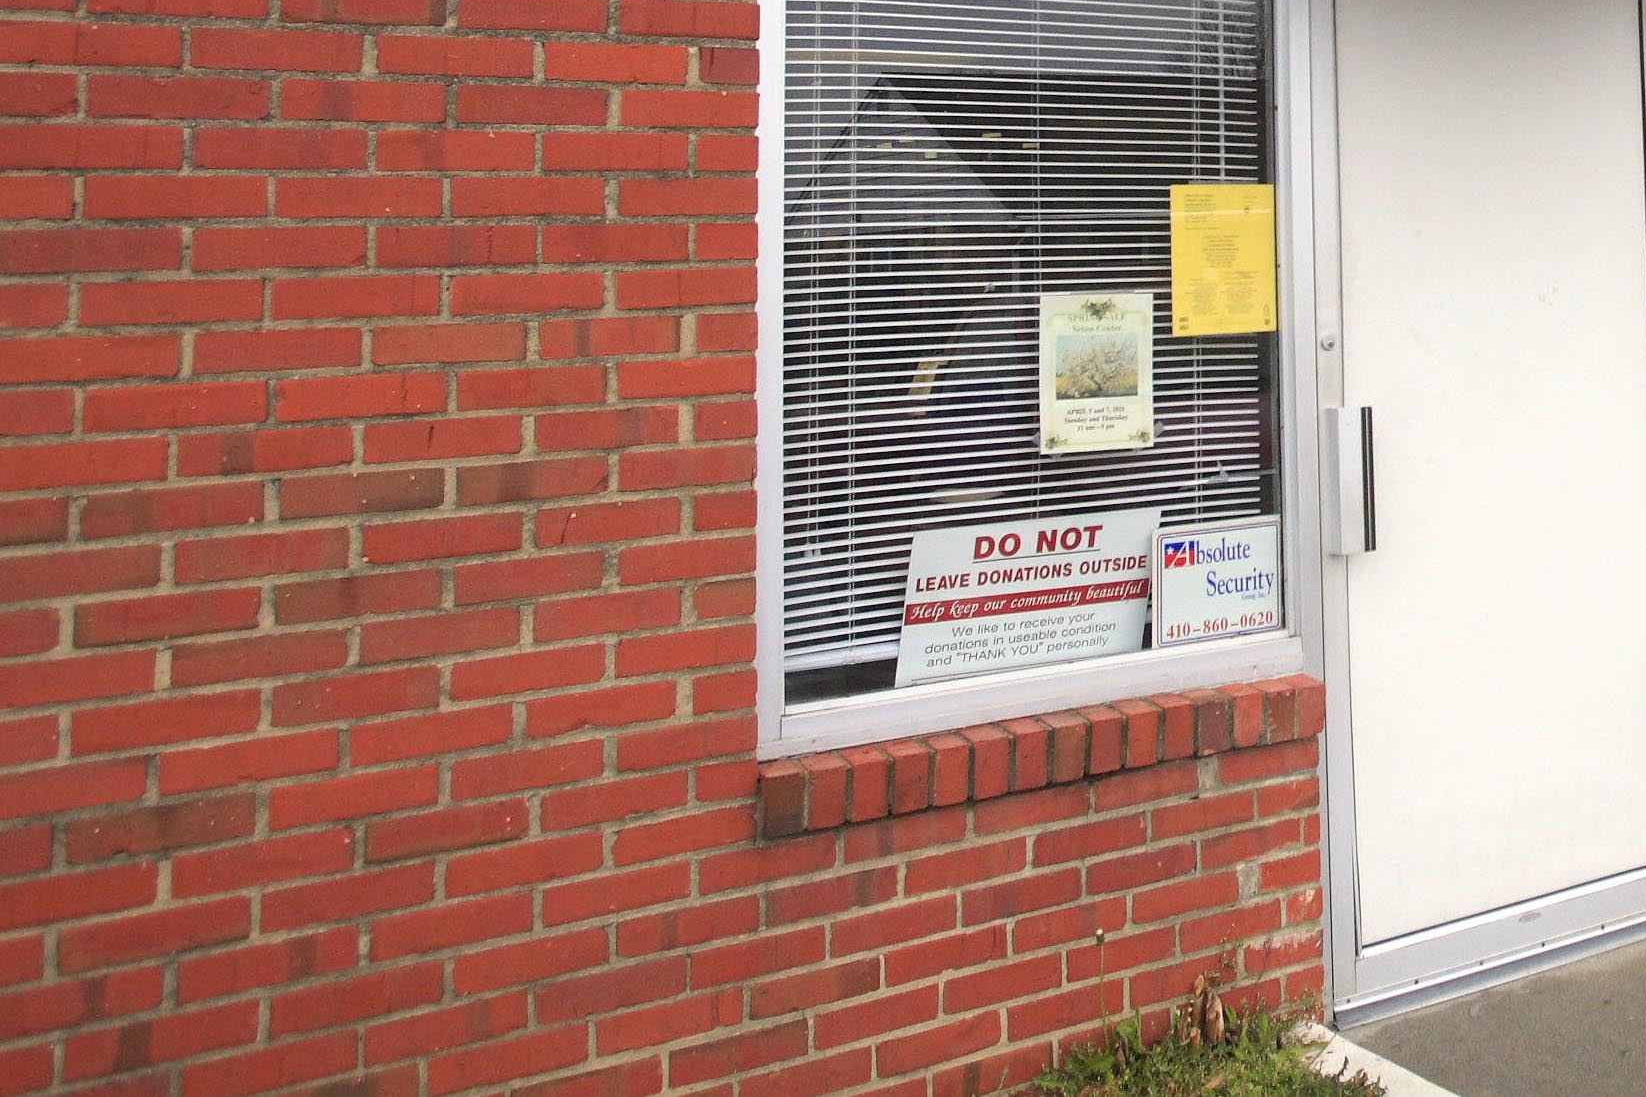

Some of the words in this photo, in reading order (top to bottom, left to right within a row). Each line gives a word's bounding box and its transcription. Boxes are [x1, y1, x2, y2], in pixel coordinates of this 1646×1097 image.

[973, 532, 1021, 560] DO
[1036, 525, 1103, 554] NOT
[1165, 537, 1251, 569] Absolute
[915, 573, 970, 593] LEAVE
[977, 562, 1073, 586] DONATIONS
[1079, 555, 1148, 575] OUTSIDE
[1206, 567, 1275, 597] Security
[910, 603, 945, 622] Help
[949, 600, 979, 618] keep
[984, 601, 1006, 611] our
[1010, 590, 1082, 609] community
[1085, 579, 1144, 601] beautiful
[924, 638, 989, 655] donations
[993, 636, 1005, 645] in
[1008, 629, 1057, 644] useable
[1061, 621, 1116, 637] condition
[951, 626, 973, 638] We
[977, 625, 998, 635] like
[1003, 621, 1016, 632] to
[1019, 615, 1065, 631] receive
[1068, 612, 1096, 629] your
[1166, 611, 1273, 639] 410-860-0620
[926, 654, 951, 668] and
[1046, 634, 1109, 654] personally
